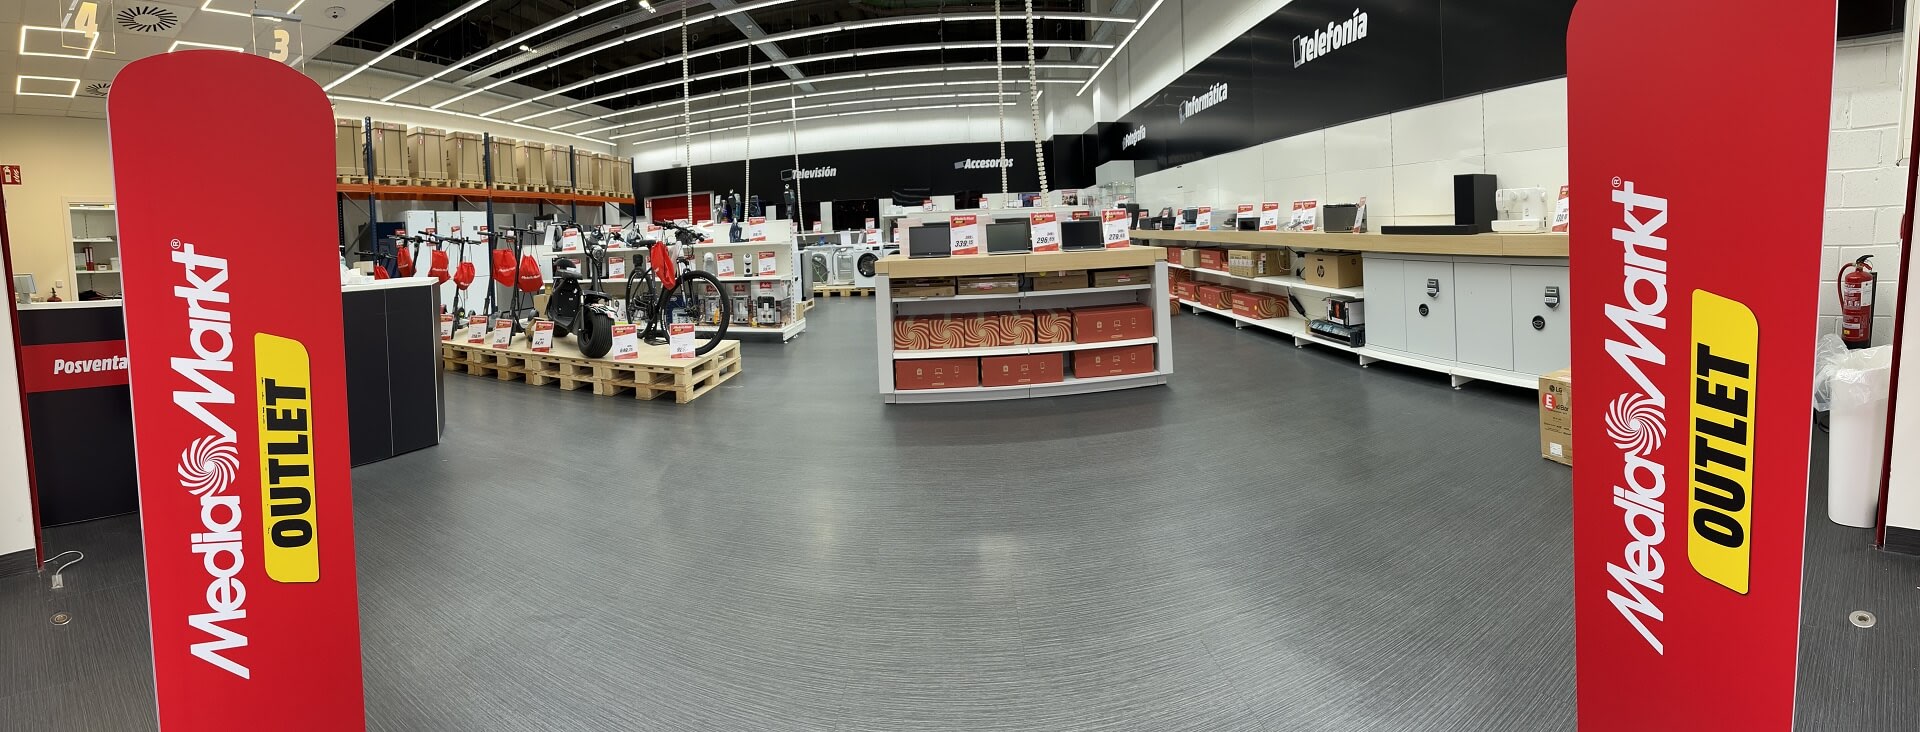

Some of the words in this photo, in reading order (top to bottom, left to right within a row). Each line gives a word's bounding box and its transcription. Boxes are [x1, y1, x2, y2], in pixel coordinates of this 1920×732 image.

[74, 2, 98, 39] 4
[1300, 7, 1368, 64] Telefonía
[268, 30, 290, 63] 3
[1185, 82, 1228, 118] Informática
[1126, 124, 1146, 147] Fotografía
[792, 166, 837, 180] Televisión
[53, 355, 129, 375] Posventa
[263, 378, 313, 548] OUTLET
[1693, 342, 1750, 549] OUTLET
